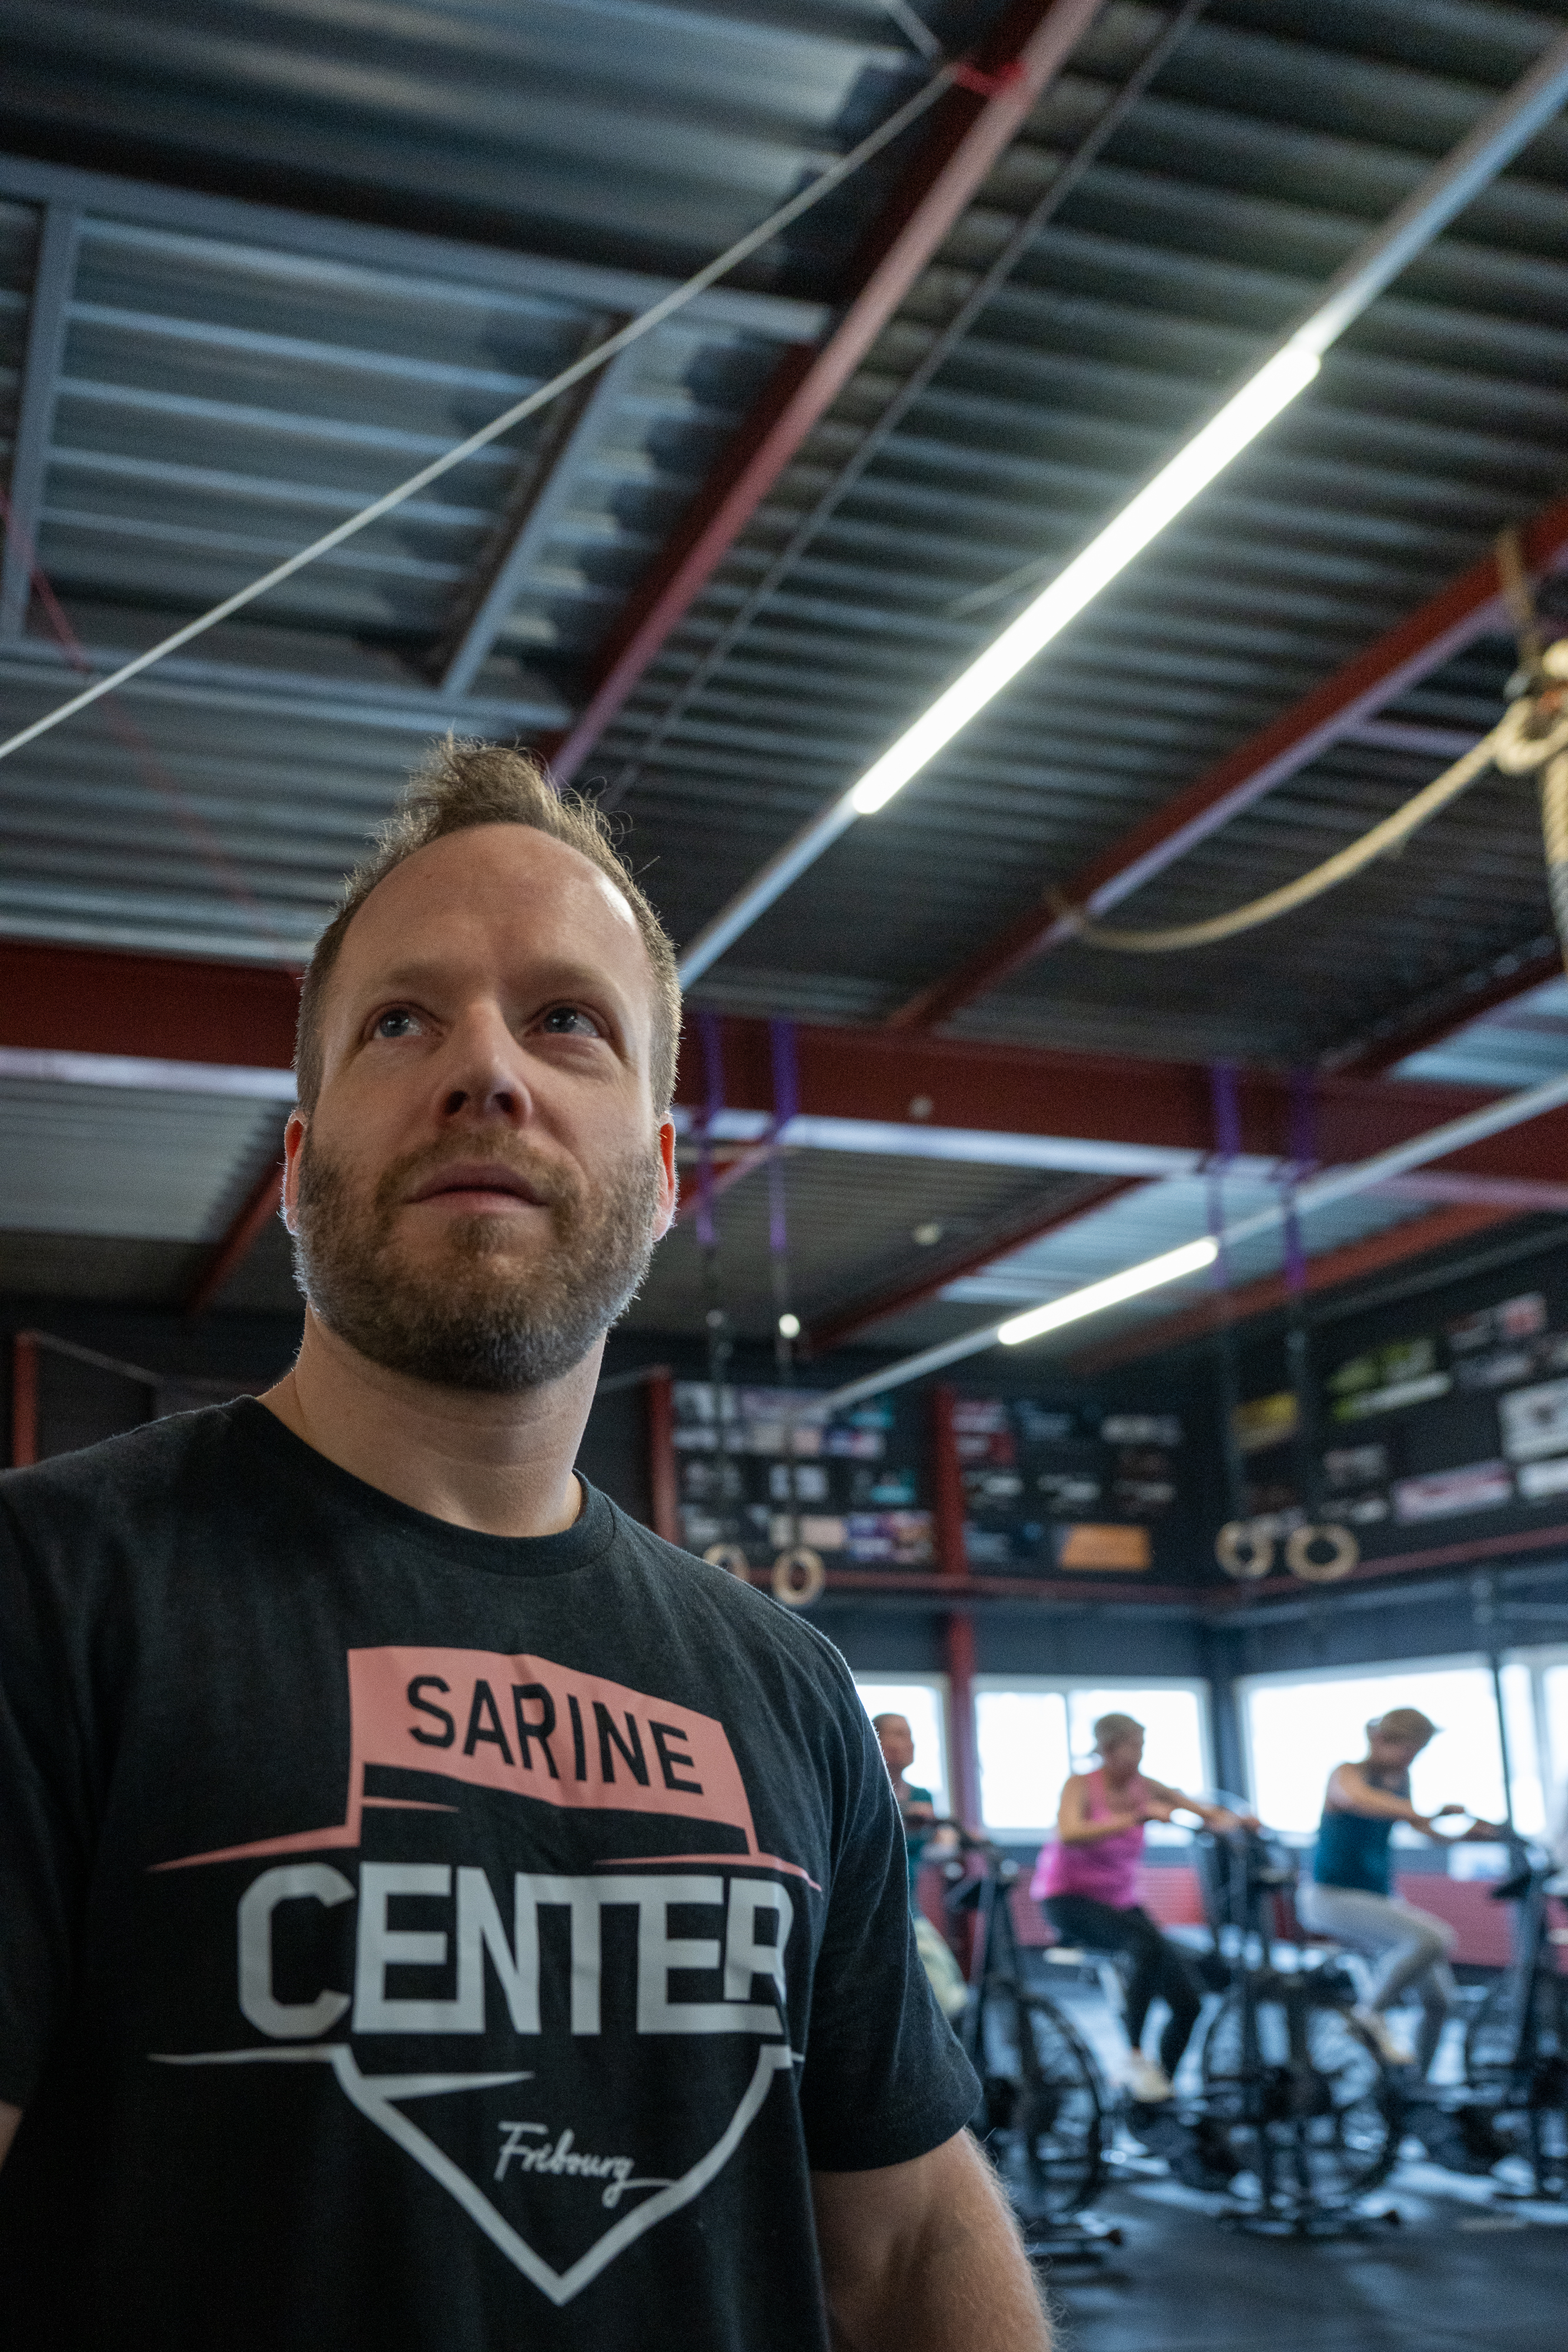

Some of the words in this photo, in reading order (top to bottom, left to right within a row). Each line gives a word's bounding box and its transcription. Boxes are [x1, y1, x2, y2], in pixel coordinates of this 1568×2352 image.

[407, 1675, 704, 1795] SARINE
[238, 1860, 794, 2039] CENTER
[494, 2120, 636, 2208] Fribourg
